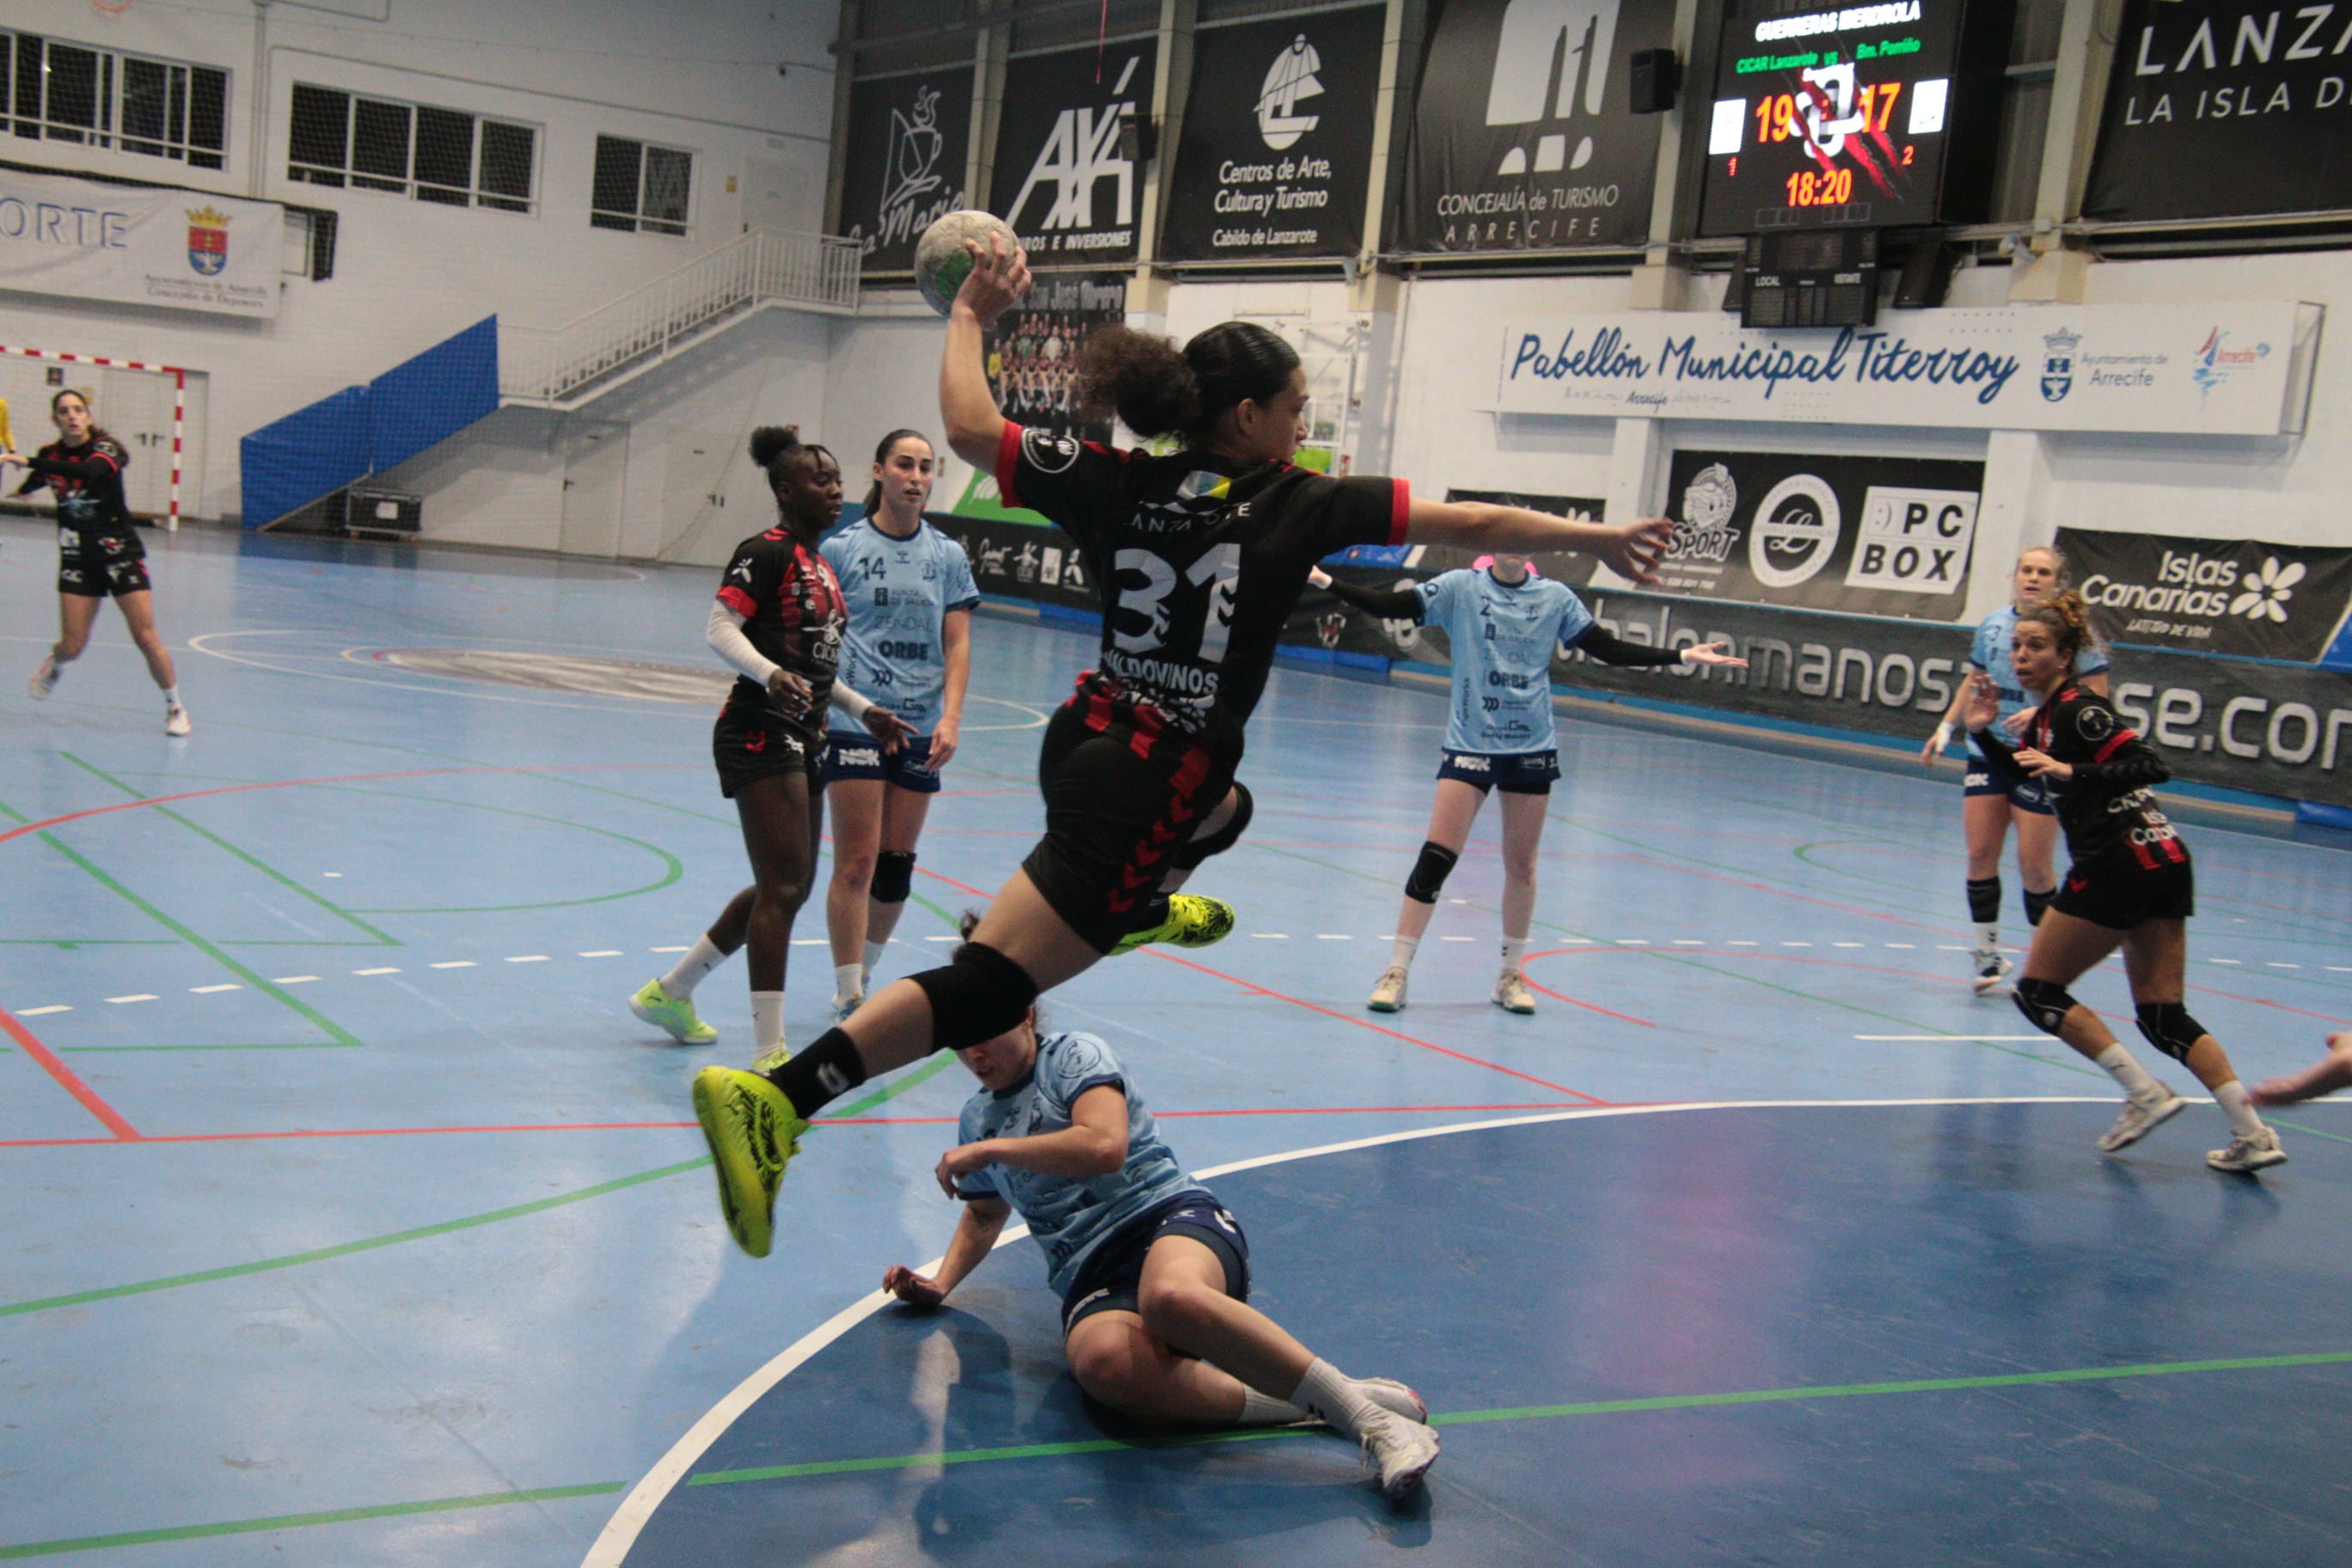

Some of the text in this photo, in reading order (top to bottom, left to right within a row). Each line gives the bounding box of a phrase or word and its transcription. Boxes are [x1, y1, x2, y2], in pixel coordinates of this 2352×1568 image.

[1736, 57, 1768, 74] CICAR
[1755, 83, 1902, 142] 19 17
[2125, 77, 2352, 126] LA ISLA D
[1219, 155, 1332, 184] Centros de Arte,
[1728, 145, 1914, 176] 1 2
[1214, 186, 1328, 217] Cultura y Turismo
[1437, 184, 1619, 216] CONCEJALÍA de TURISMO
[1786, 168, 1852, 206] 18:20
[1051, 236, 1061, 250] E
[1065, 230, 1131, 250] INVERSIONES
[1212, 227, 1318, 247] Cabildo de Lanzarote
[1444, 217, 1600, 242] ARRECIFE
[1755, 276, 1780, 287] LOCAL
[1510, 326, 2020, 405] Pabellón Municipal Titerroy
[2081, 352, 2169, 369] Ayuntamiento de
[2089, 367, 2155, 387] Arrecife
[1902, 502, 1964, 538] PC
[1666, 522, 1741, 561] SPORT
[858, 557, 886, 580] 14
[1859, 543, 1957, 581] BOX
[2158, 550, 2239, 586] Islas
[1114, 542, 1241, 664] 31
[2079, 573, 2230, 617] Canarias
[879, 640, 928, 661] ORBE
[1488, 670, 1529, 689] ORBE
